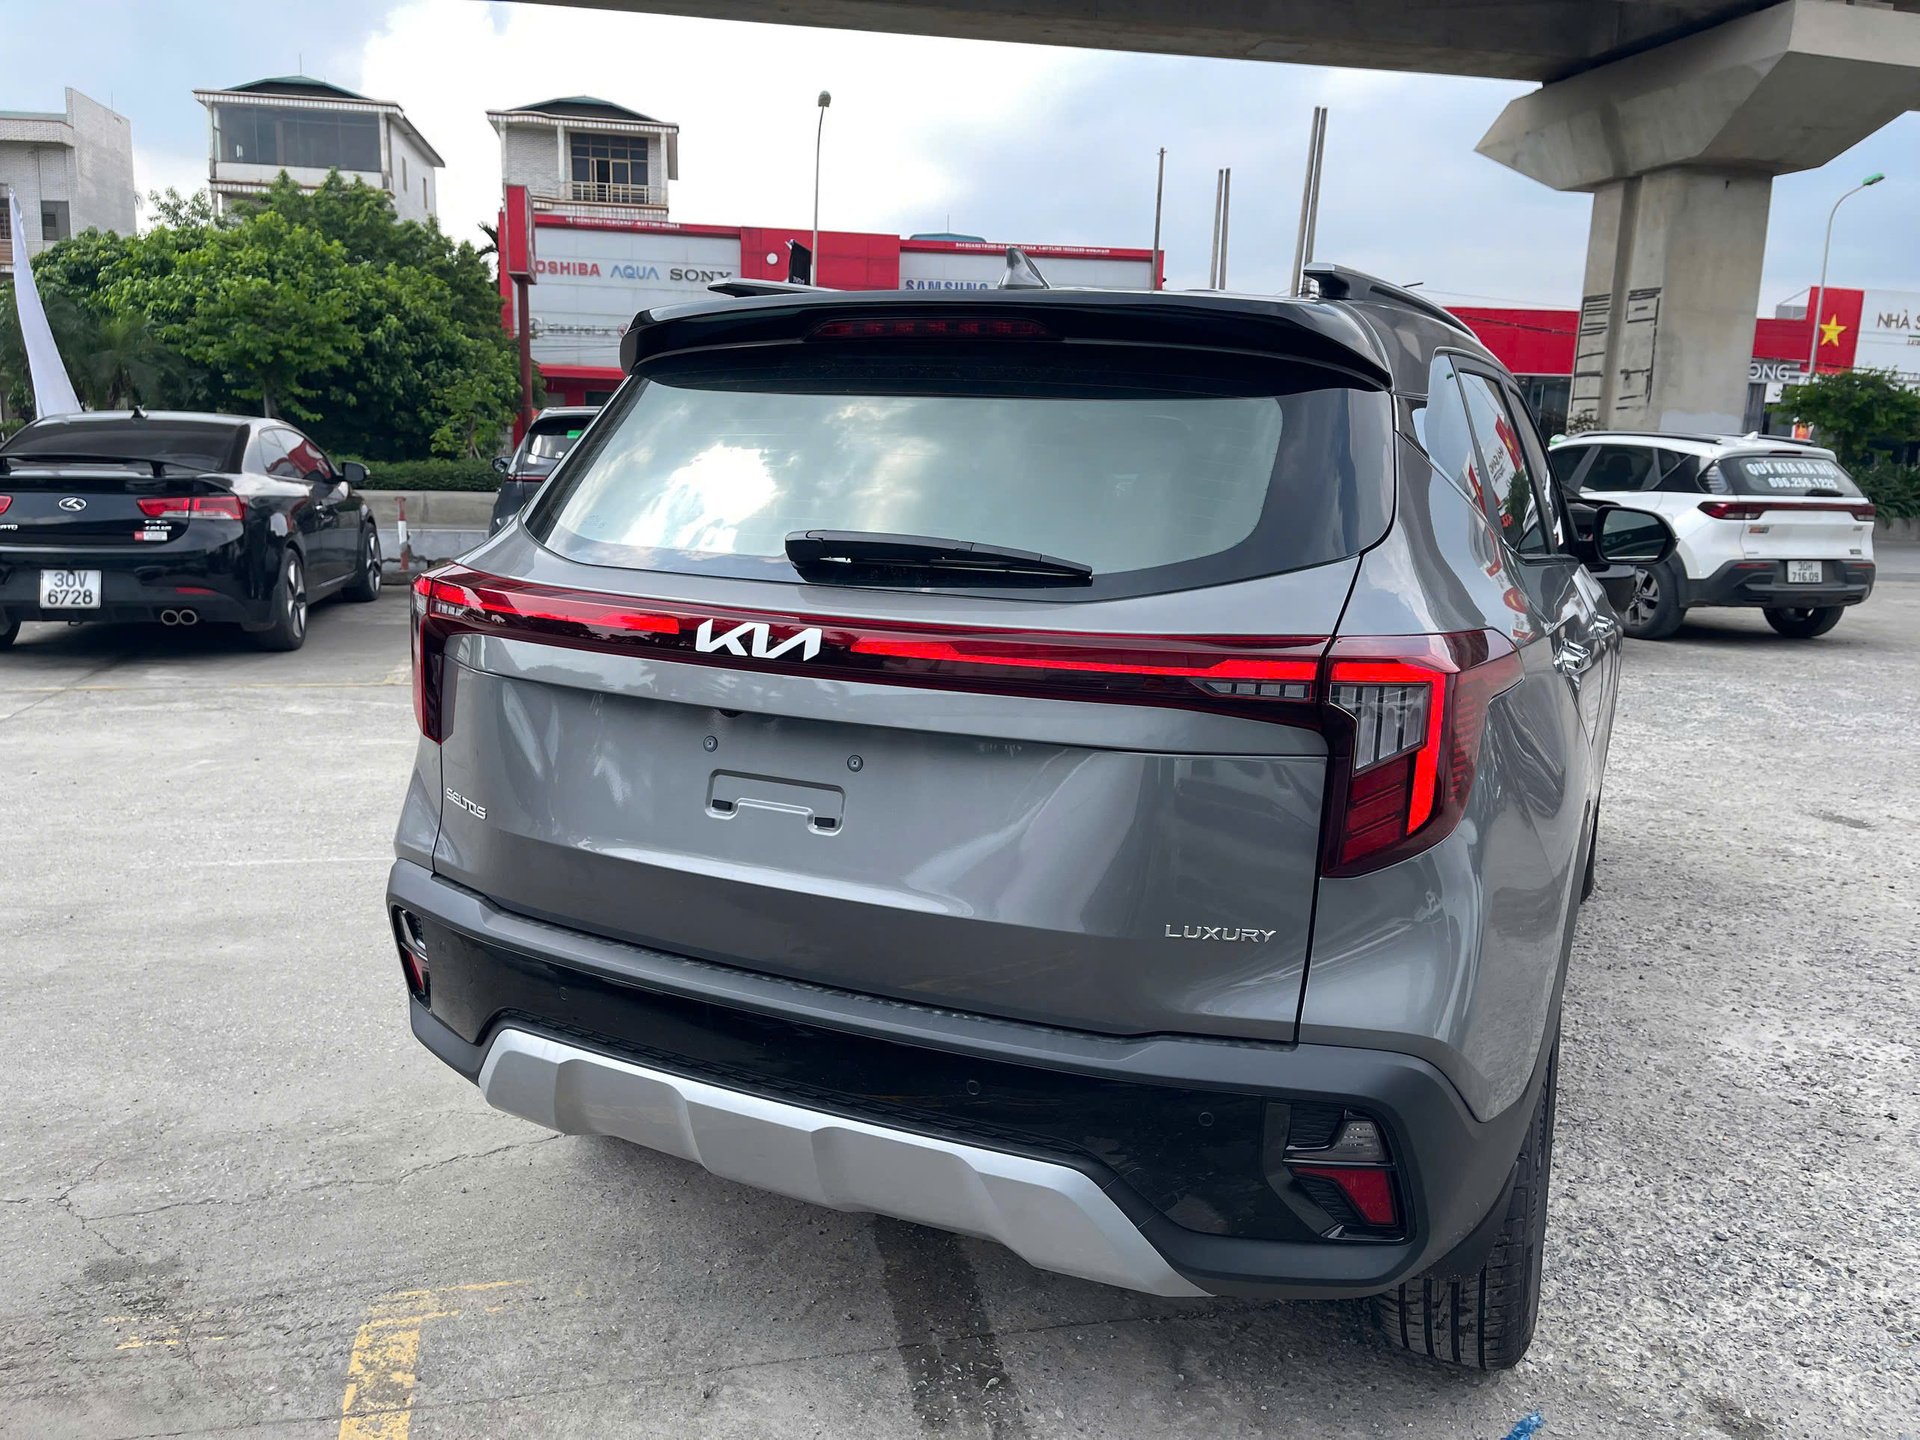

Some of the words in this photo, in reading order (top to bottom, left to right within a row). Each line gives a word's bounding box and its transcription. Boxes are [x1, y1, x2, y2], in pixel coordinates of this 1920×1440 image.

[535, 260, 601, 277] OSHIBA
[610, 264, 660, 280] AQUA
[1877, 308, 1911, 330] NHÀ
[1774, 462, 1797, 475] KIA
[1796, 461, 1817, 475] HÀ
[54, 571, 88, 588] 30V
[47, 589, 93, 605] 6728
[695, 618, 822, 662] KIA
[446, 787, 487, 820] SELTOS
[1164, 924, 1277, 943] LUXURY
